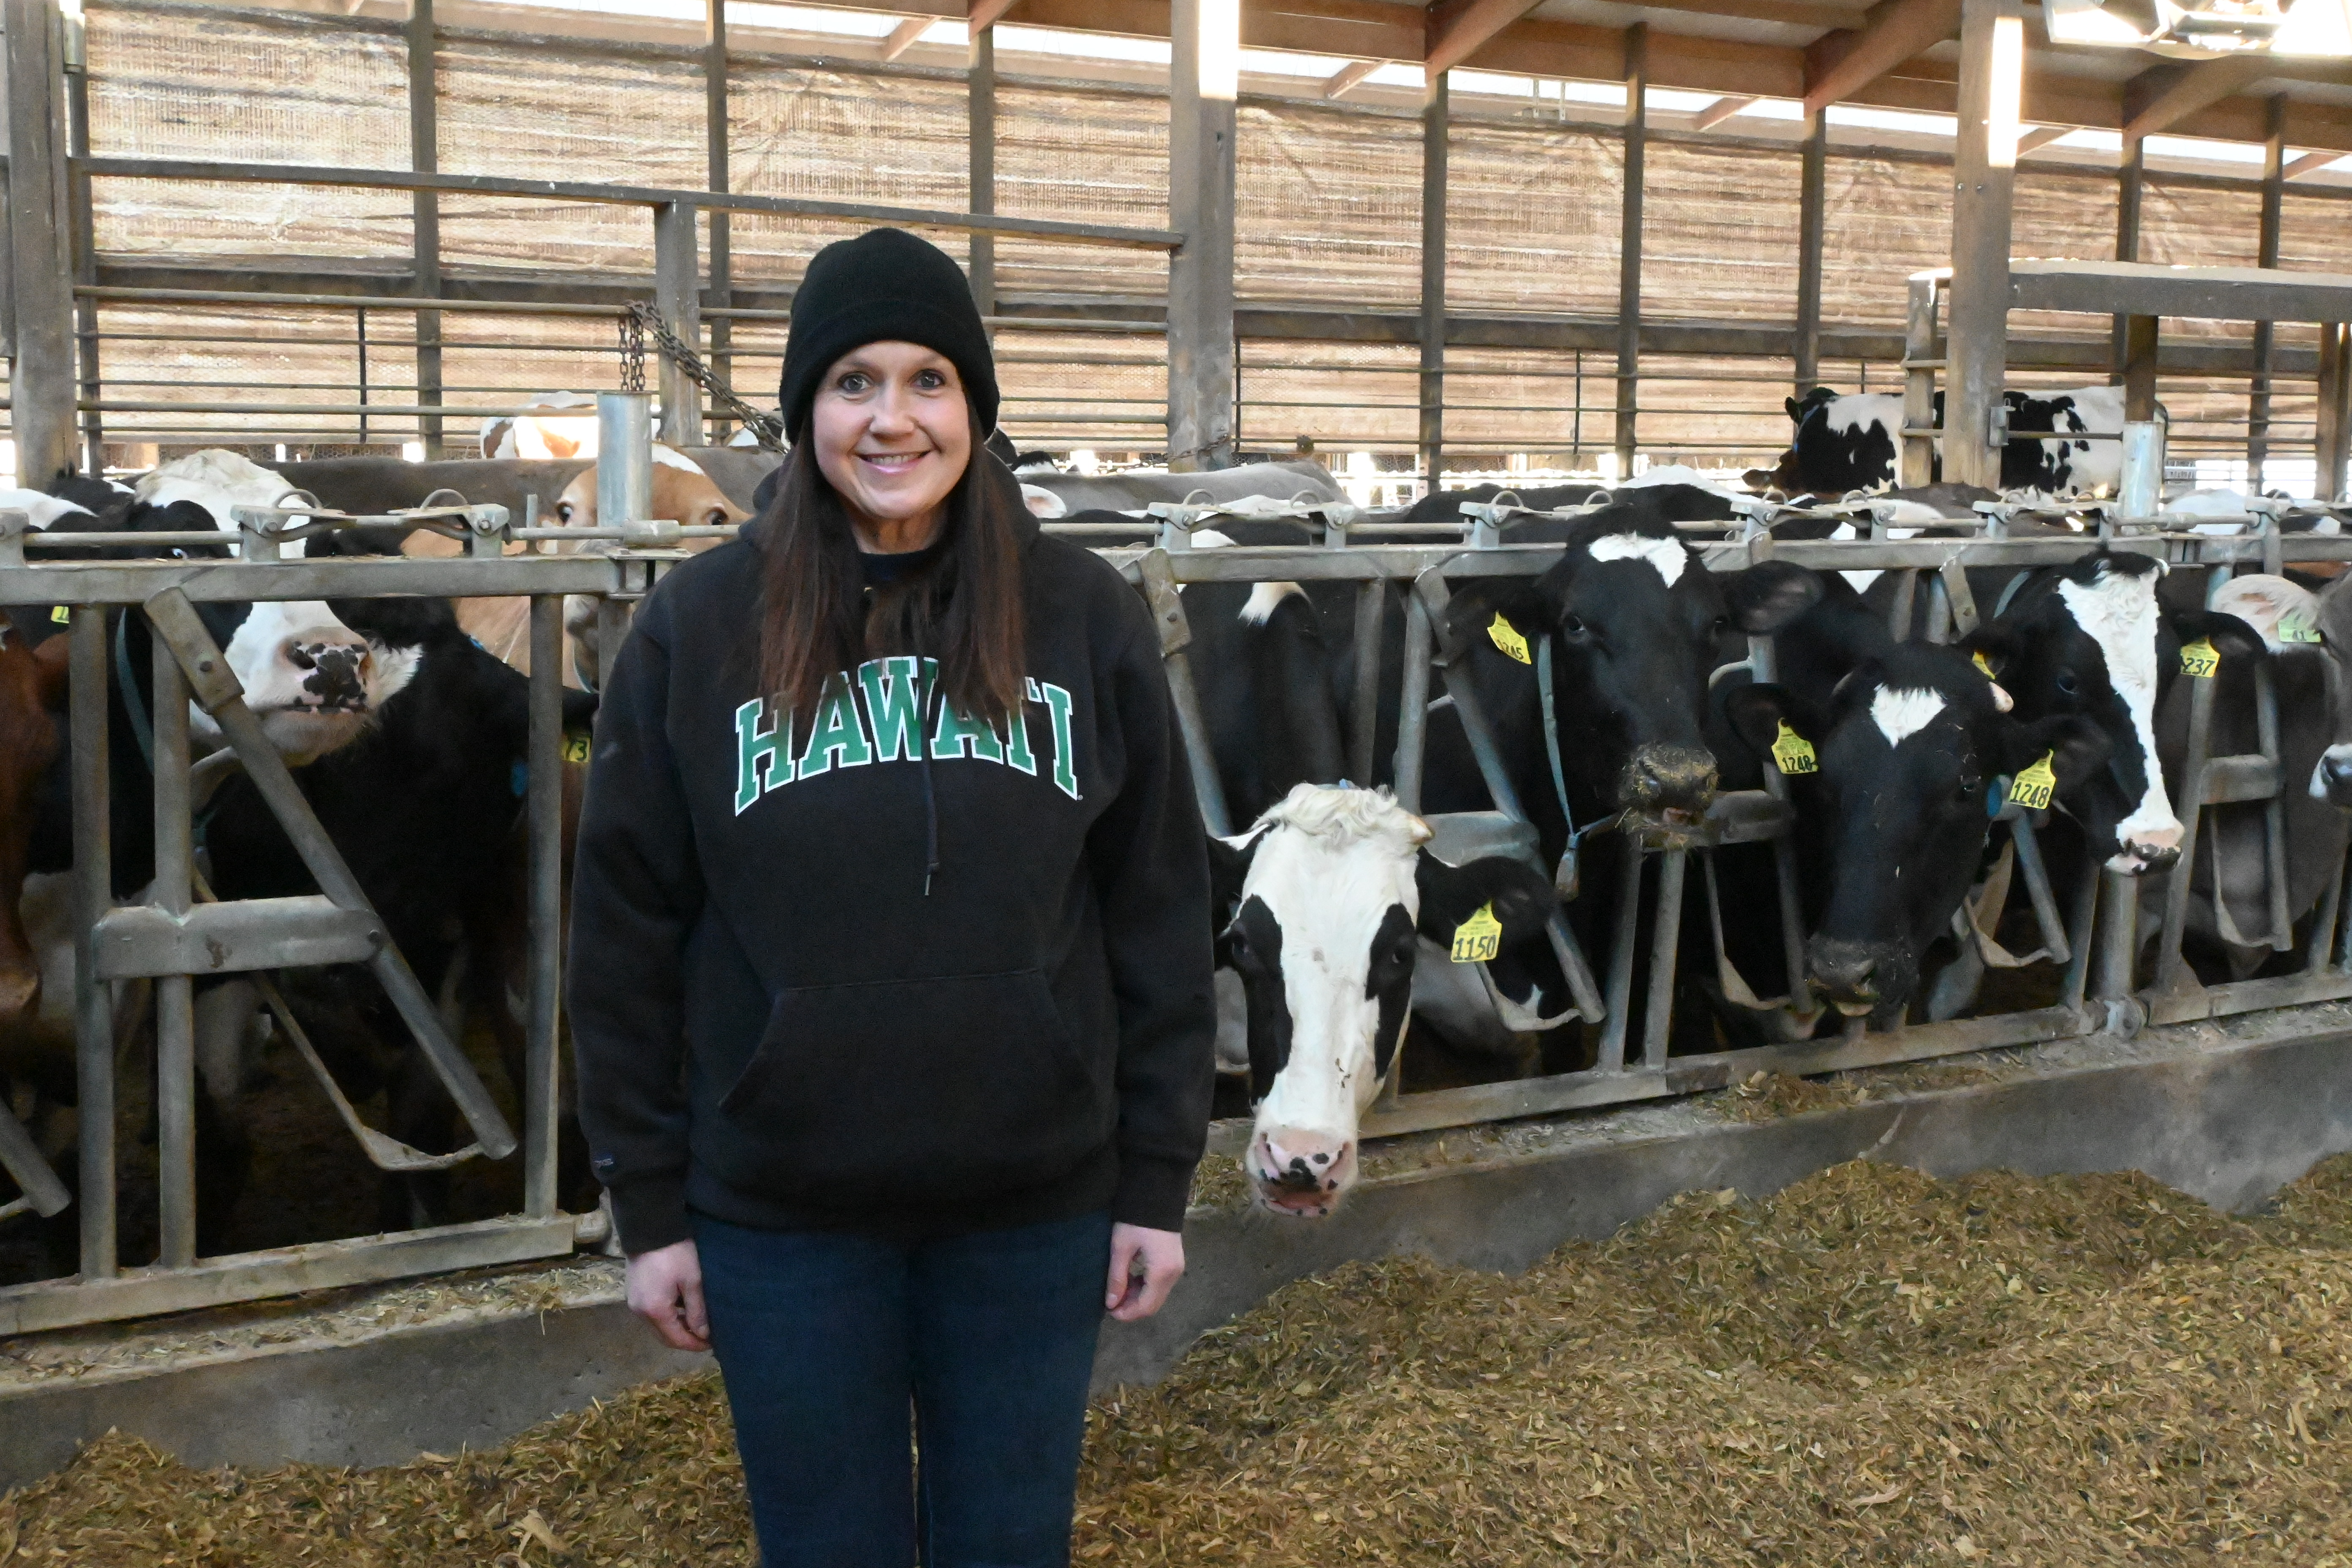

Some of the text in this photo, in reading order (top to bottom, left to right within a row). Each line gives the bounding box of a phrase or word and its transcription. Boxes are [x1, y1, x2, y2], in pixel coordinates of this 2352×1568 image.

[2182, 657, 2216, 675] 237
[2009, 782, 2050, 808] 1248
[1453, 935, 1496, 960] 1150
